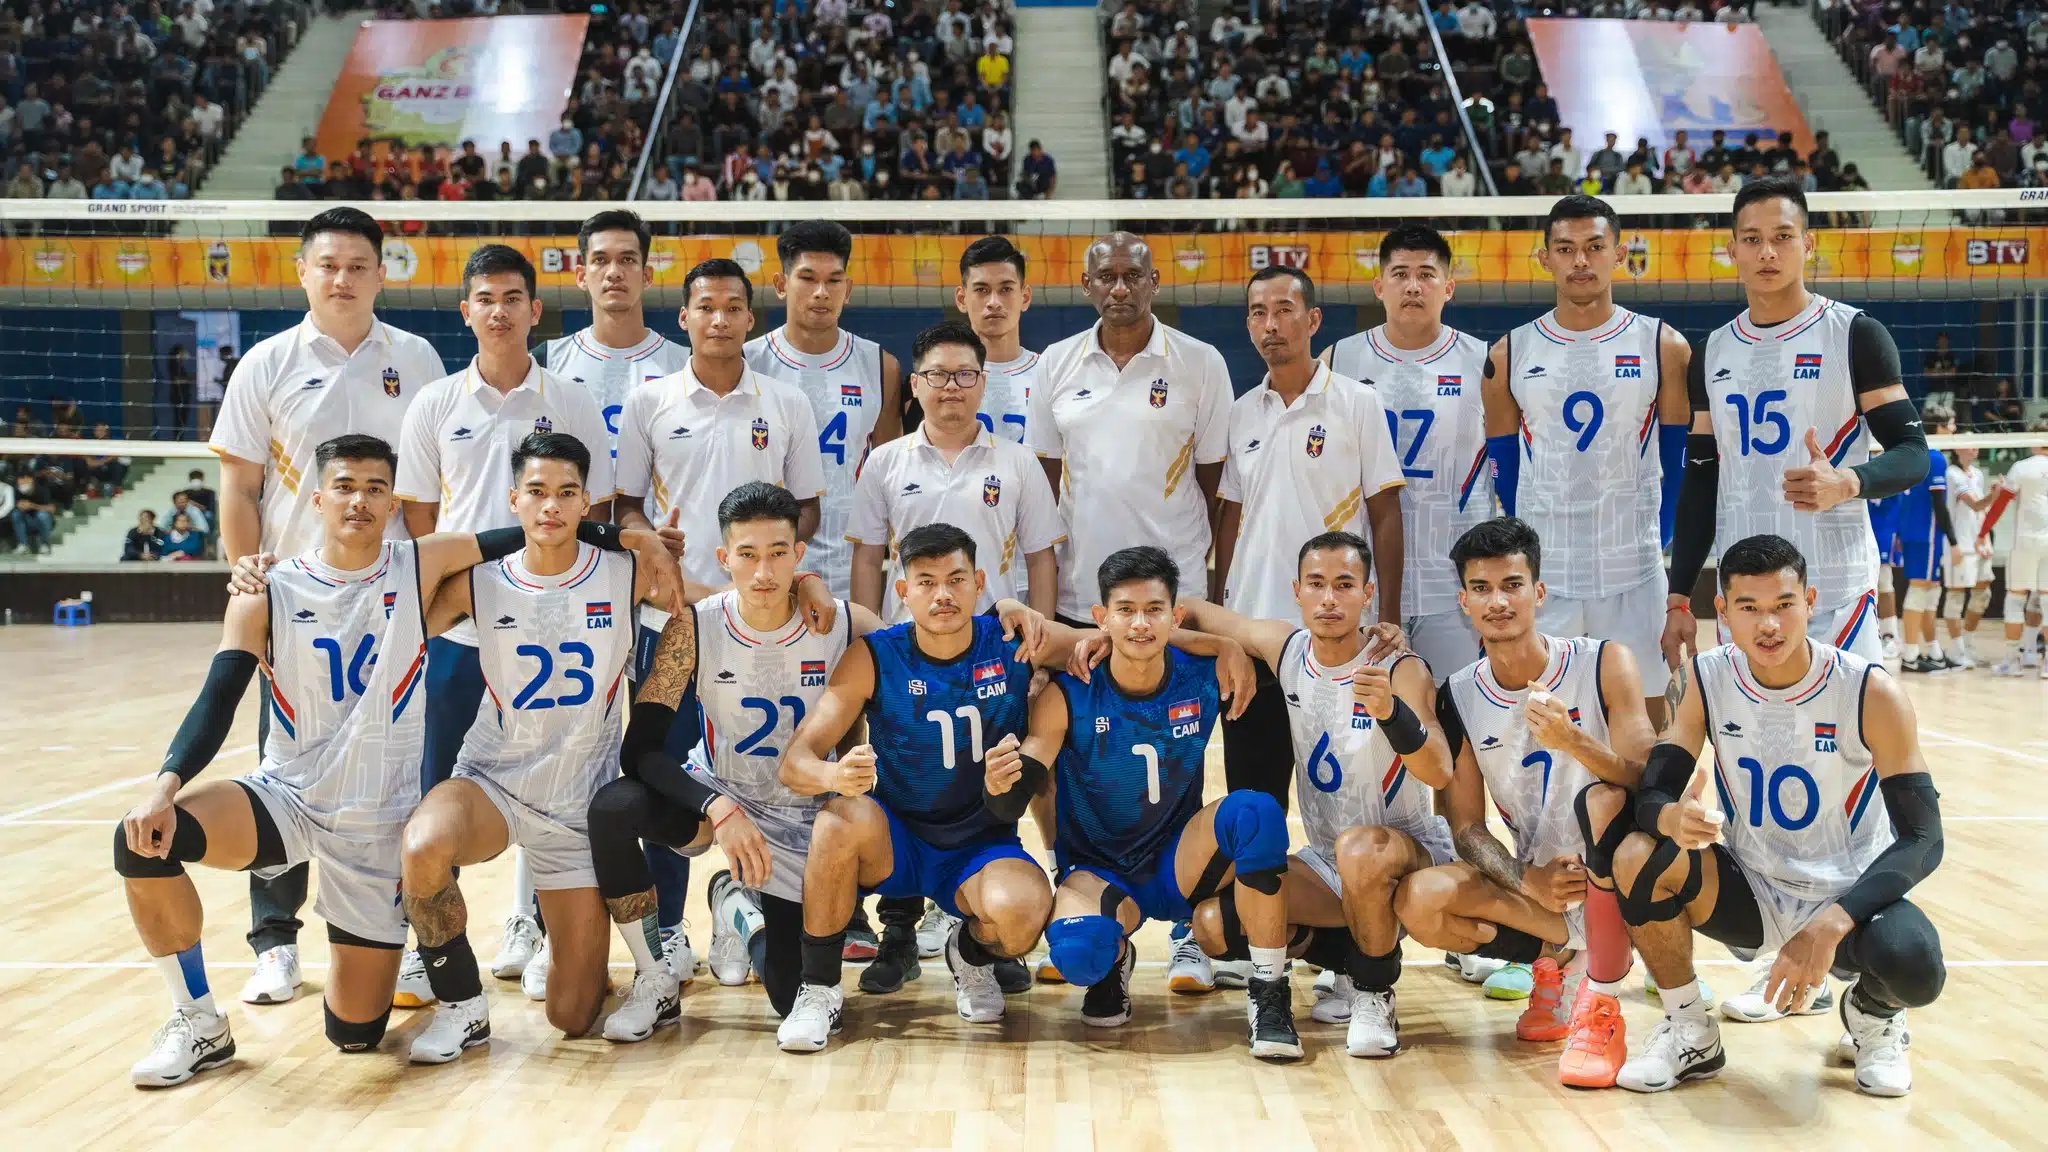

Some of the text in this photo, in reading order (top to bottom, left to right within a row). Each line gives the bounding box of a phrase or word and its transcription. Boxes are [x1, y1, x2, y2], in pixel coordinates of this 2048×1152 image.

[377, 84, 448, 101] GANZ
[88, 204, 127, 213] GRAND
[130, 204, 167, 213] SPORT
[542, 248, 582, 273] BT
[1615, 368, 1641, 379] CAM
[1792, 368, 1820, 380] CAM
[1437, 387, 1461, 397] CAM
[841, 396, 863, 408] CAM
[1562, 390, 1604, 453] 9
[1725, 389, 1791, 457] 15
[586, 616, 613, 630] CAM
[312, 633, 380, 702] 16
[511, 641, 595, 711] 23
[800, 675, 826, 688] CAM
[976, 680, 1008, 700] CAM
[1171, 720, 1201, 739] CAM
[1351, 717, 1373, 730] CAM
[926, 704, 984, 770] 11
[1307, 730, 1344, 794] 6
[1131, 743, 1161, 805] 1
[1737, 756, 1820, 831] 10
